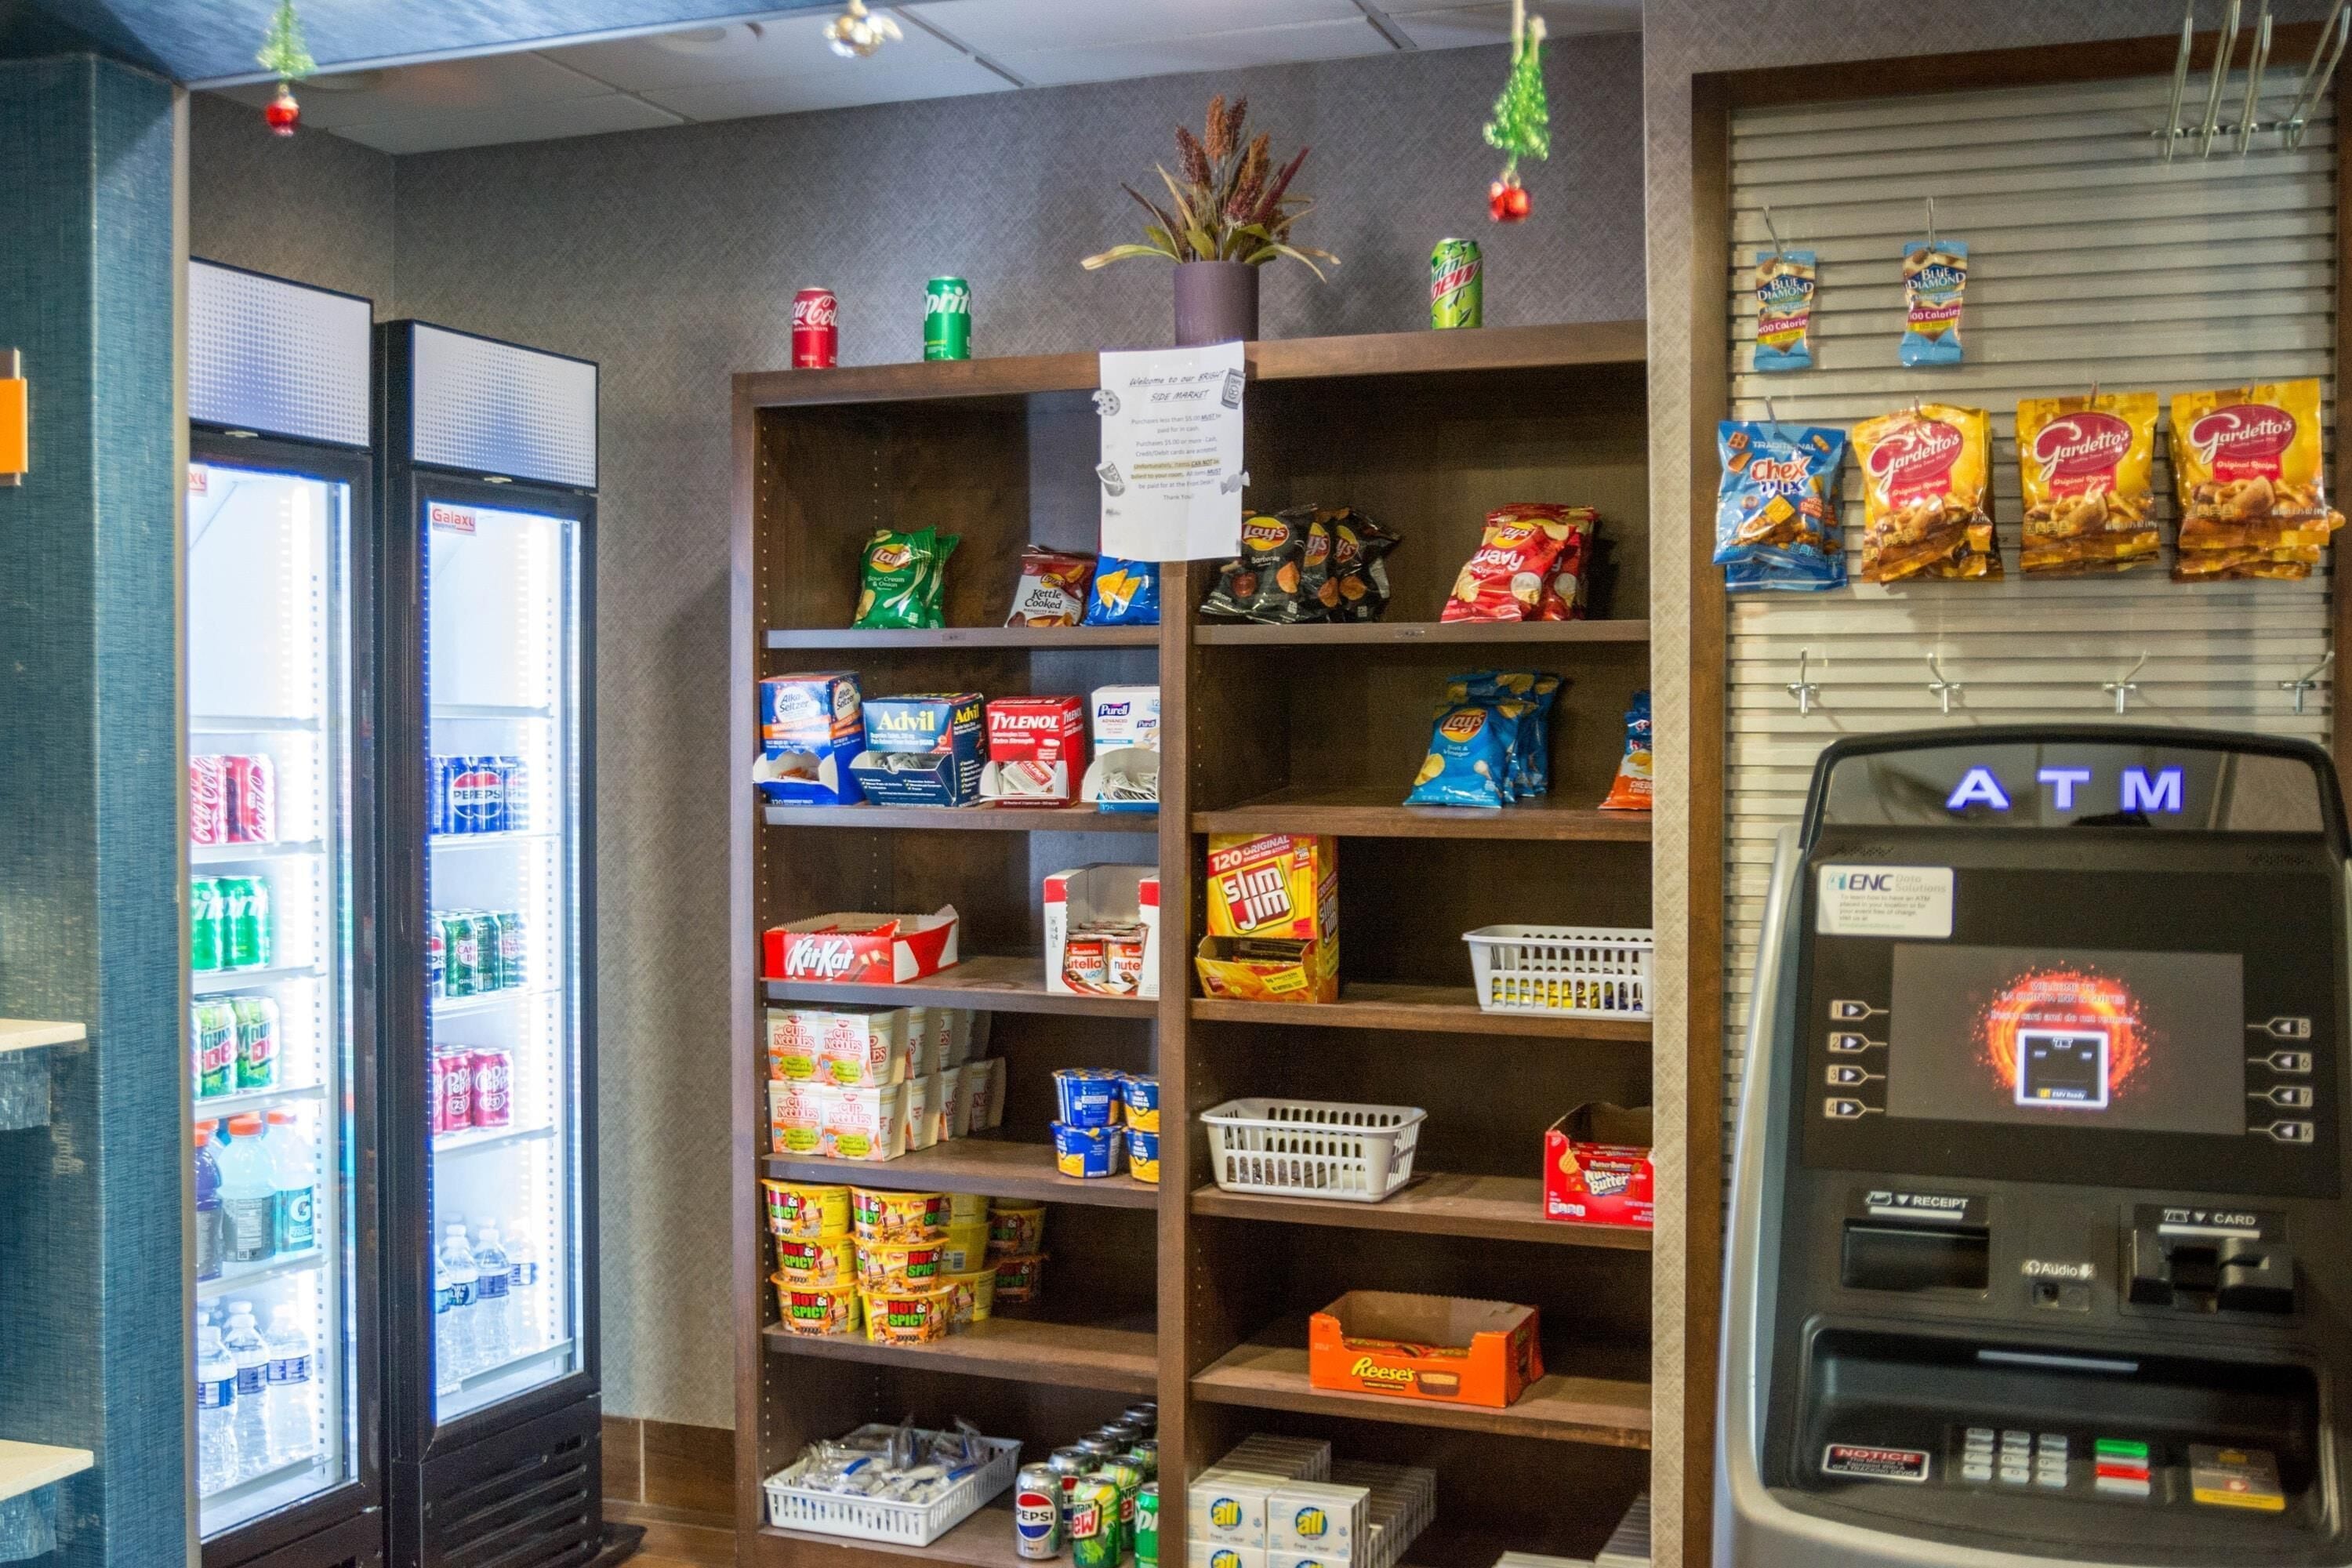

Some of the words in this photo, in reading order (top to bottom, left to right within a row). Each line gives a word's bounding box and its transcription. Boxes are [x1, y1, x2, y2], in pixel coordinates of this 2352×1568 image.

[1922, 267, 1951, 279] BLUE
[1771, 278, 1798, 290] BLUE
[1907, 273, 1965, 289] DIAMOND
[1757, 281, 1814, 301] DIAMOND
[1130, 376, 1164, 386] Welcome
[1150, 392, 1170, 401] SIDE
[1173, 389, 1210, 399] MARKET
[1201, 413, 1215, 422] MUST
[2190, 413, 2292, 465] Gardetto's
[2033, 422, 2129, 482] Gardetto's
[1868, 431, 1960, 493] Gardetto's
[2216, 461, 2250, 470] Original
[2251, 461, 2278, 470] Recipe
[1207, 467, 1221, 476] MUST
[1751, 457, 1811, 482] Chex
[1892, 484, 1922, 496] Original
[1922, 478, 1947, 490] Recipe
[2053, 477, 2084, 487] Original
[433, 509, 475, 532] Galaxy
[1243, 527, 1287, 542] Lay's
[1251, 555, 1280, 564] Barbecue
[1042, 574, 1065, 586] Lay's
[1032, 589, 1062, 600] Kettle
[1025, 598, 1062, 610] Cooked
[781, 694, 804, 704] Alka-
[837, 695, 855, 710] Seltzer
[779, 700, 809, 713] Seltzer
[1101, 703, 1127, 715] Purell
[877, 710, 935, 731] Advil
[954, 704, 980, 725] Advil
[990, 711, 1059, 731] TYLENOL
[1063, 706, 1083, 725] TYLENOL
[1443, 712, 1486, 734] Lay's
[1212, 850, 1243, 872] 120
[1243, 835, 1290, 856] ORIGINAL
[1849, 873, 1894, 891] ENC
[1896, 874, 1922, 884] Data
[1895, 884, 1947, 893] Solutions
[787, 939, 855, 978] KitKat
[2031, 982, 2079, 992] WELCOME
[2082, 983, 2096, 992] TO
[2057, 993, 2077, 1004] INN
[2020, 1011, 2042, 1021] card
[2043, 1013, 2063, 1022] and
[2064, 1014, 2077, 1022] do
[2079, 1014, 2096, 1023] not
[784, 1025, 806, 1036] CUP
[833, 1029, 855, 1040] CUP
[774, 1034, 815, 1047] NOODLES
[824, 1037, 862, 1051] NOODLES
[2067, 1091, 2085, 1100] Ready
[786, 1098, 809, 1108] CUP
[840, 1103, 862, 1114] CUP
[778, 1107, 818, 1120] NOODLES
[829, 1112, 872, 1126] NOODLES
[1590, 1176, 1628, 1195] Butter
[290, 1194, 312, 1222] G
[789, 1196, 798, 1207] &
[1913, 1196, 1969, 1209] RECEIPT
[2214, 1214, 2256, 1225] CARD
[782, 1241, 805, 1257] HOT
[804, 1247, 815, 1257] &
[784, 1254, 815, 1269] SPICY
[908, 1251, 932, 1265] HOT
[932, 1252, 939, 1261] &
[2041, 1263, 2078, 1276] Audio
[791, 1292, 817, 1306] HOT
[816, 1296, 827, 1306] &
[792, 1305, 828, 1319] SPICY
[888, 1301, 917, 1314] HOT
[916, 1304, 926, 1313] &
[887, 1313, 926, 1327] SPICY
[1352, 1356, 1415, 1382] Reese's
[1839, 1449, 1918, 1462] NOTICE
[1850, 1465, 1889, 1474] TRACKING
[1212, 1501, 1240, 1525] all
[1297, 1510, 1326, 1535] all
[1210, 1533, 1222, 1541] free
[1212, 1554, 1240, 1568] all
